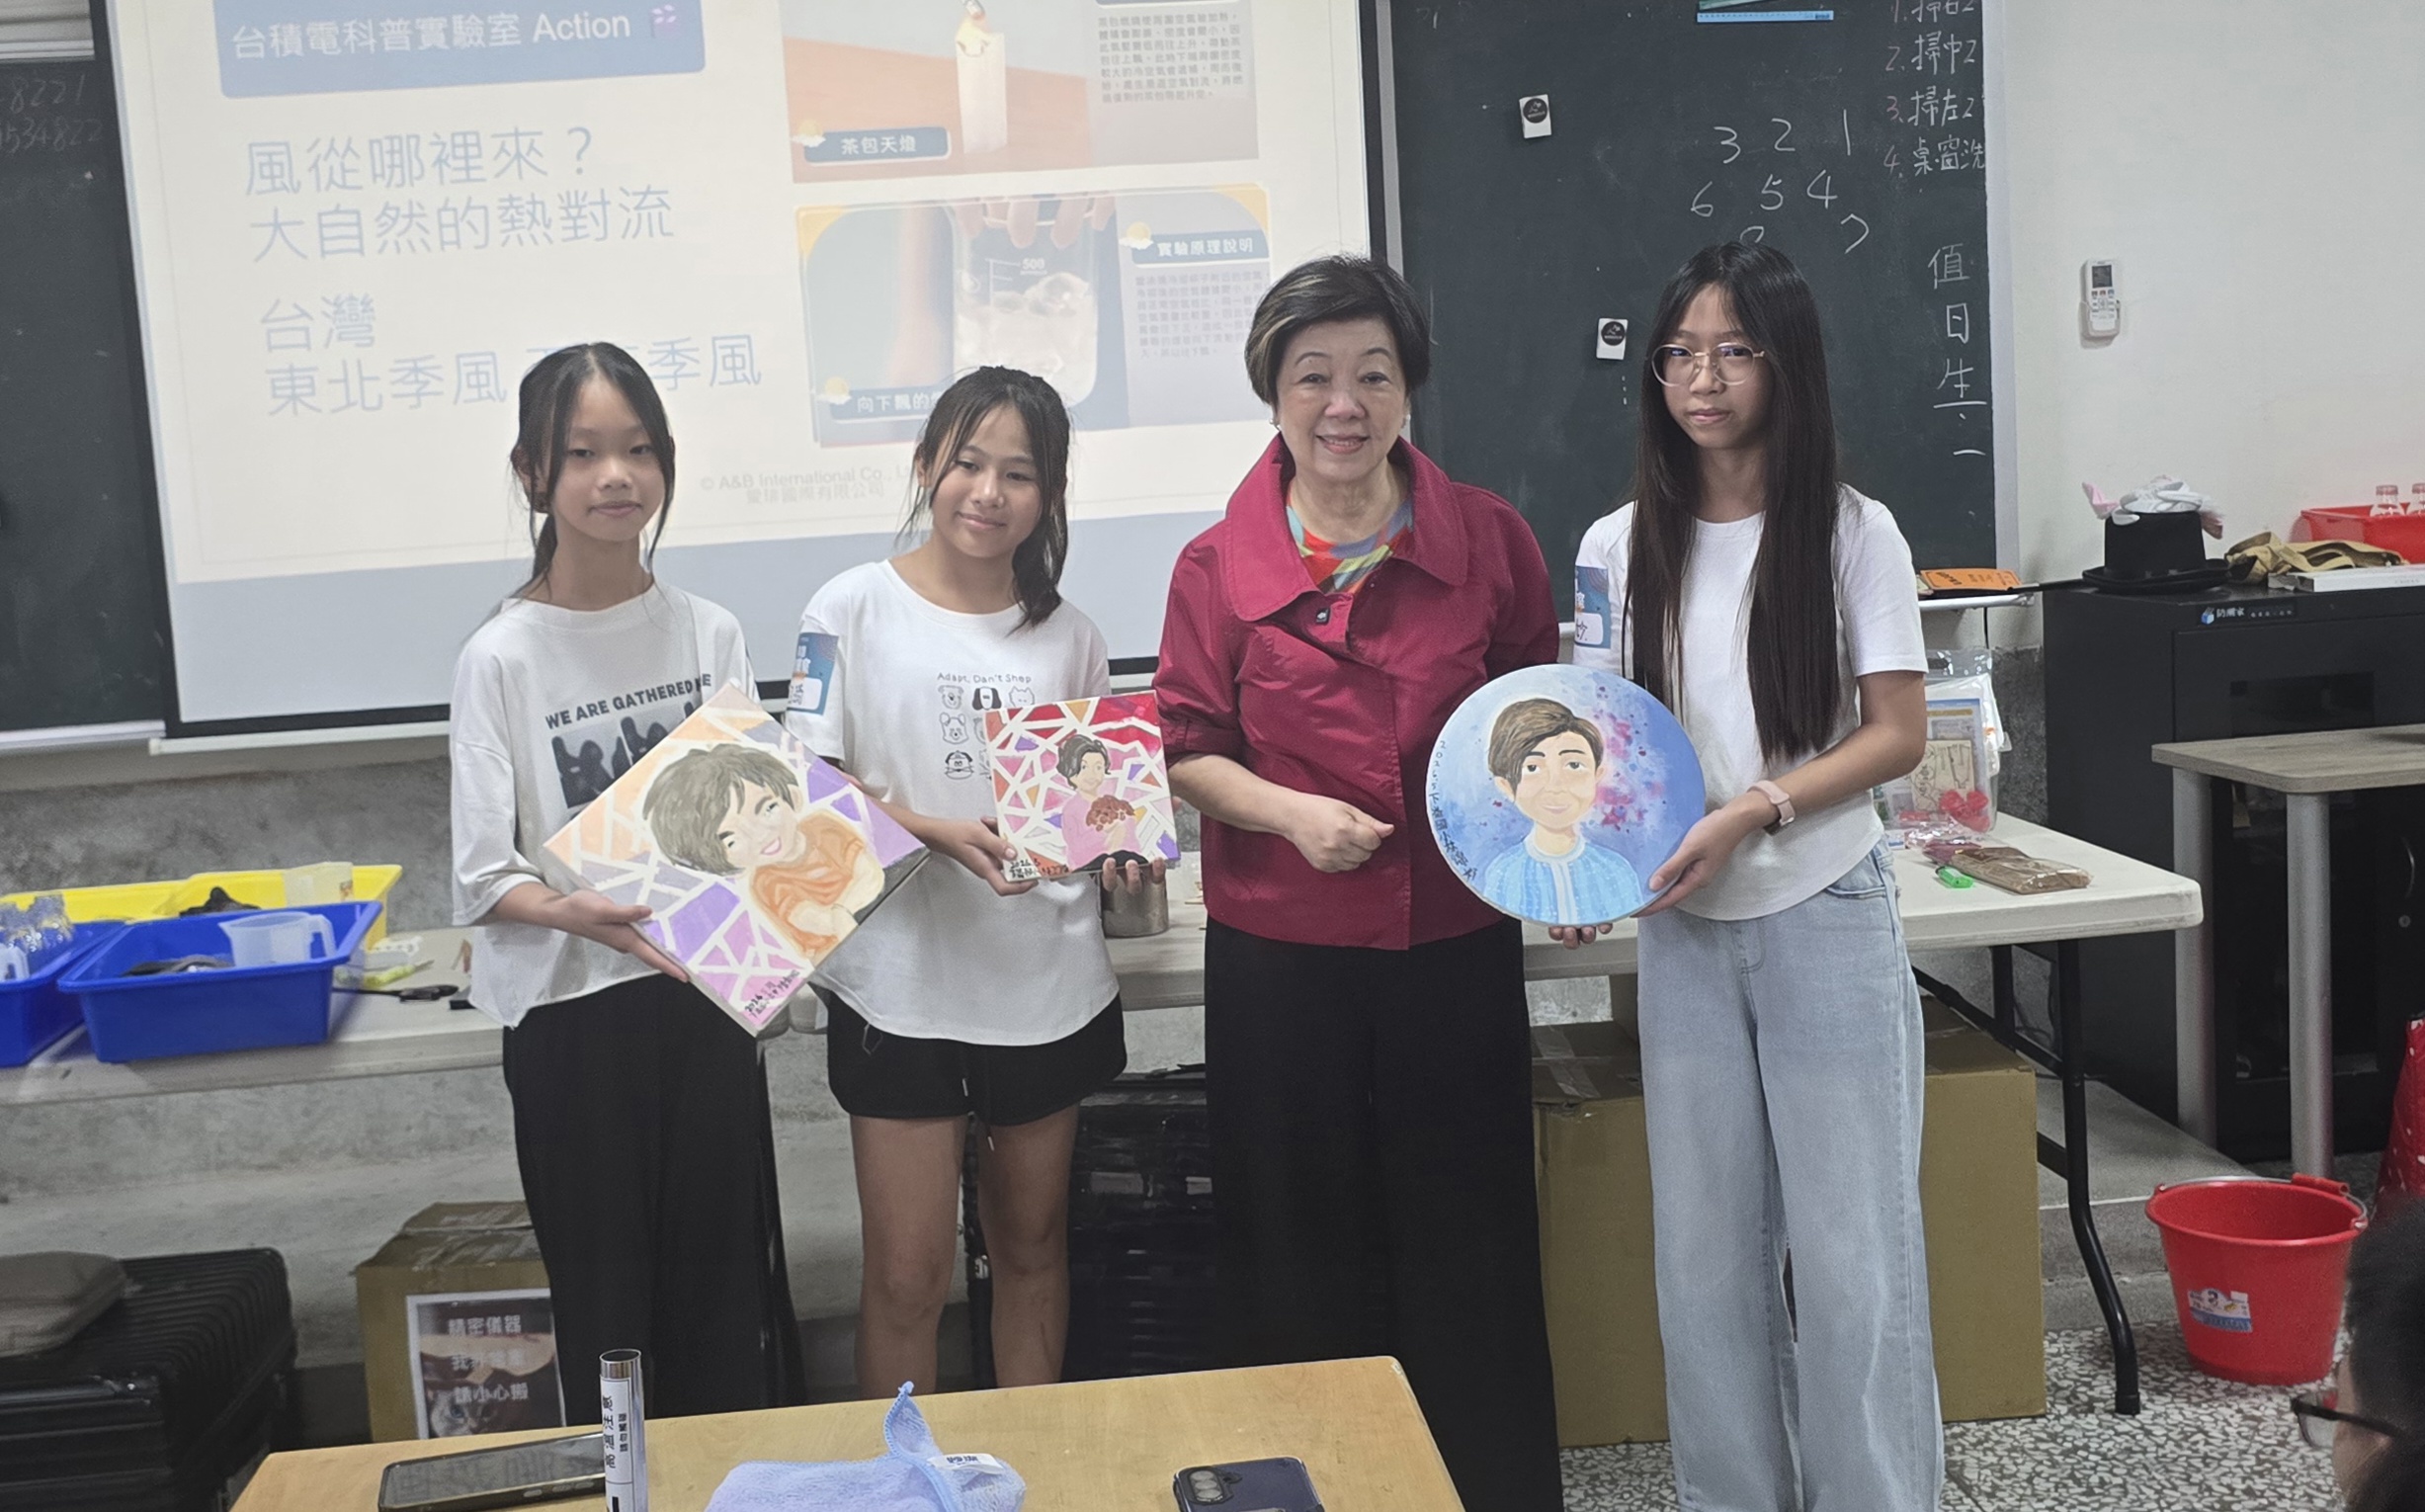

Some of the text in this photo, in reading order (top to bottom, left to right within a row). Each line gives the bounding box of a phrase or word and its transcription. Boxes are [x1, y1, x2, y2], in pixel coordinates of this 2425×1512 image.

[231, 11, 631, 60] 台積電科普實驗室 Action
[244, 126, 595, 199] 風從哪裡來？
[840, 134, 918, 156] 茶包天燈
[1713, 126, 1742, 164] 3
[1771, 118, 1796, 151] 2
[1690, 169, 1838, 217] 6 5 4
[250, 184, 675, 263] 大自然的熱對流
[1022, 257, 1045, 270] 500
[1156, 237, 1254, 258] 實驗原理說明
[259, 292, 377, 354] 台灣
[266, 349, 508, 417] 東北季風
[718, 473, 754, 491] A&B
[758, 467, 856, 487] International
[545, 709, 573, 729] WE
[576, 700, 611, 721] ARE
[612, 679, 694, 711] GATHERED
[448, 1314, 522, 1336] 精密儀器
[453, 1382, 529, 1403] 請小心搬
